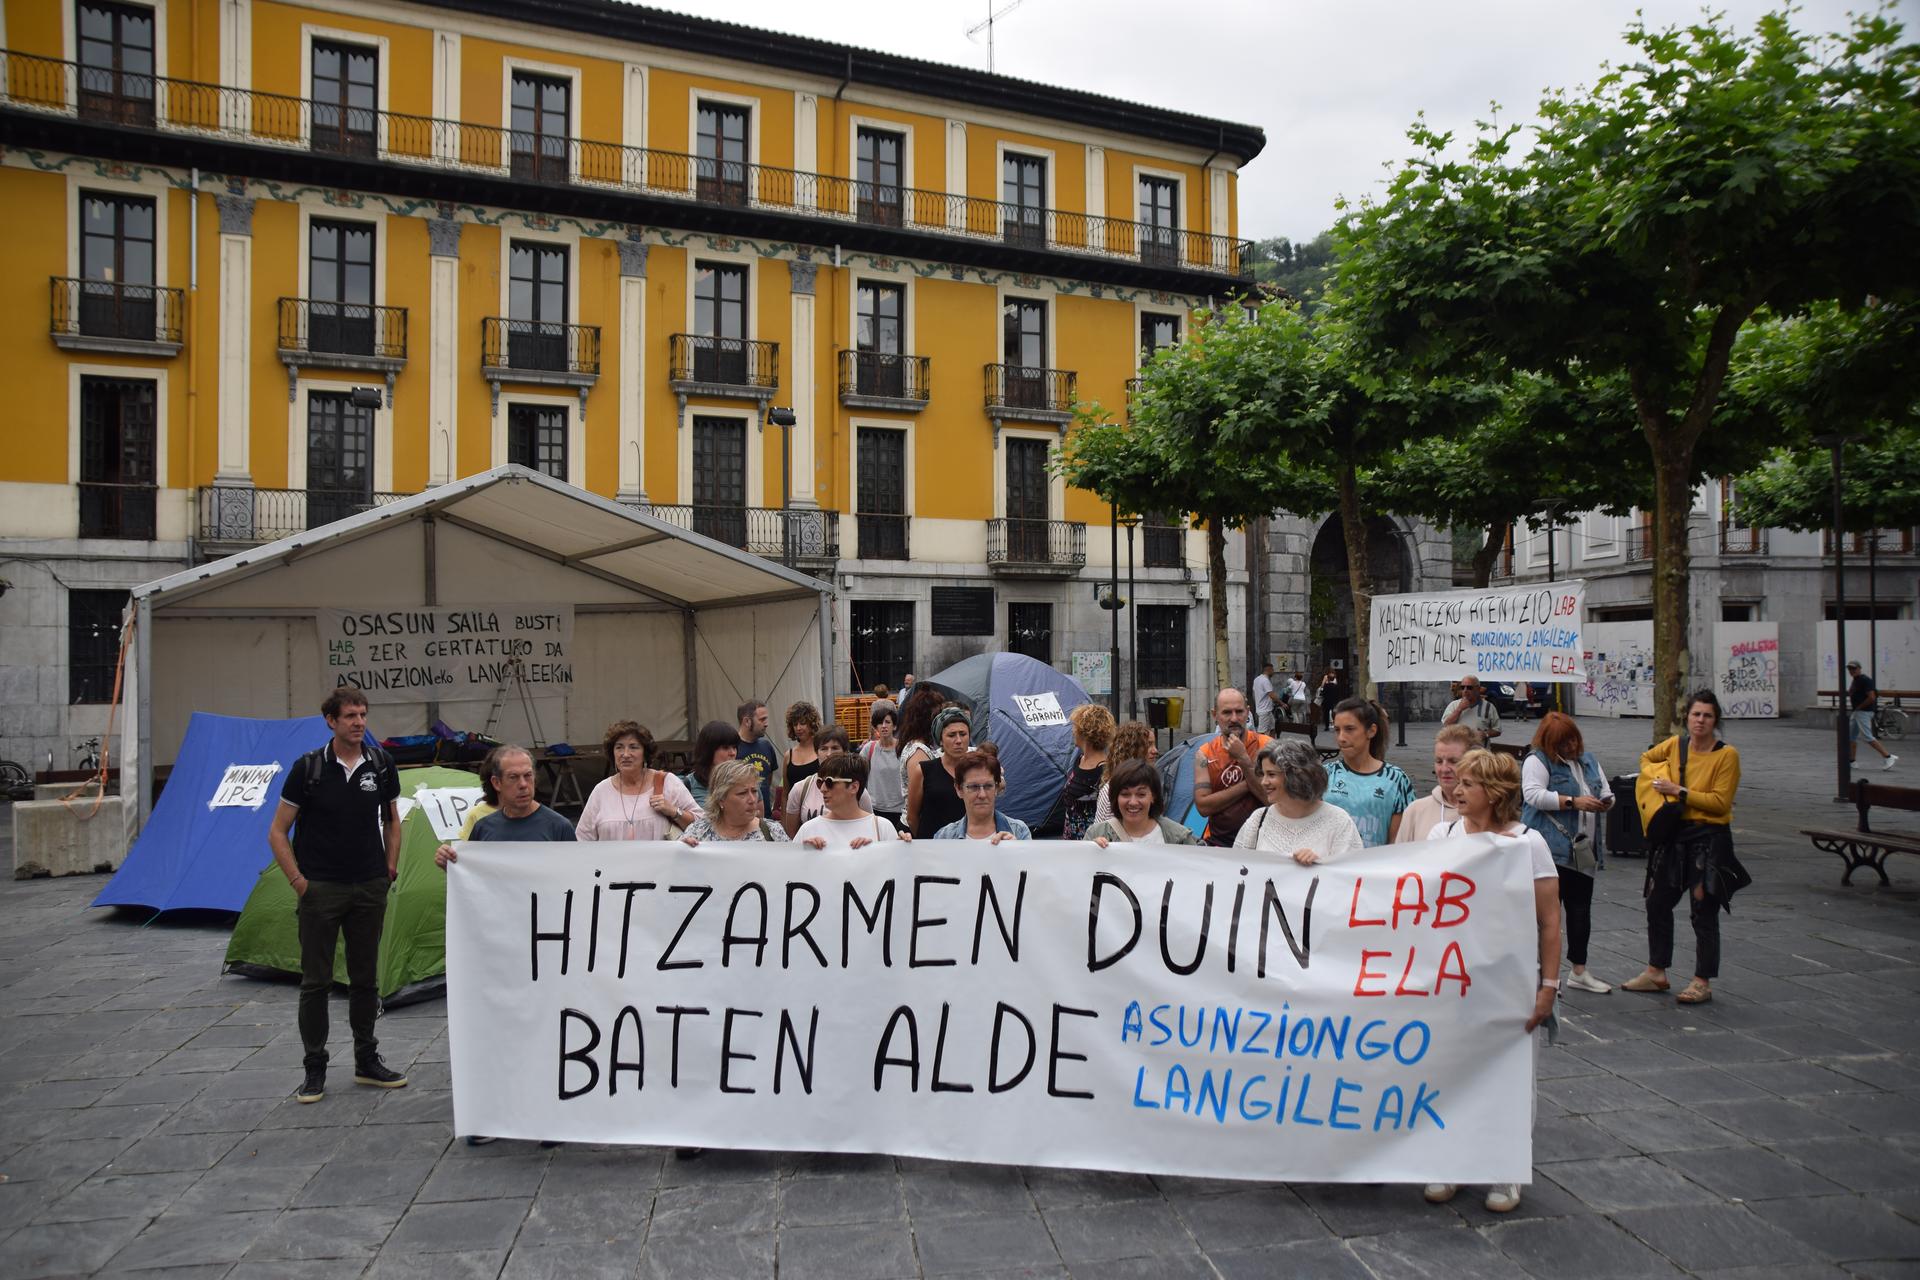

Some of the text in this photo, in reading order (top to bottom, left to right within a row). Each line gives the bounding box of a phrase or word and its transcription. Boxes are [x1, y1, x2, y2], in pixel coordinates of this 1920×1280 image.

[1554, 596, 1576, 616] LAB
[342, 612, 436, 636] OSASUN
[447, 611, 500, 634] SAILA
[329, 639, 355, 653] LAB
[1471, 626, 1579, 650] ASUNZIONGO LANGILEAK
[329, 654, 356, 666] ELA
[369, 642, 408, 662] ZER
[545, 642, 563, 657] DA
[1387, 634, 1467, 669] BATEN ALDE
[1477, 651, 1542, 673] BORROKAN
[1551, 656, 1575, 675] ELA
[1348, 871, 1477, 930] LAB
[530, 866, 1320, 981] HITZARMEN DUIN
[1353, 941, 1472, 998] ELA
[1121, 1000, 1431, 1066] ASUNZIONGO
[558, 1001, 1099, 1100] BATEN ALDE
[1133, 1064, 1446, 1132] LANGILEAK
